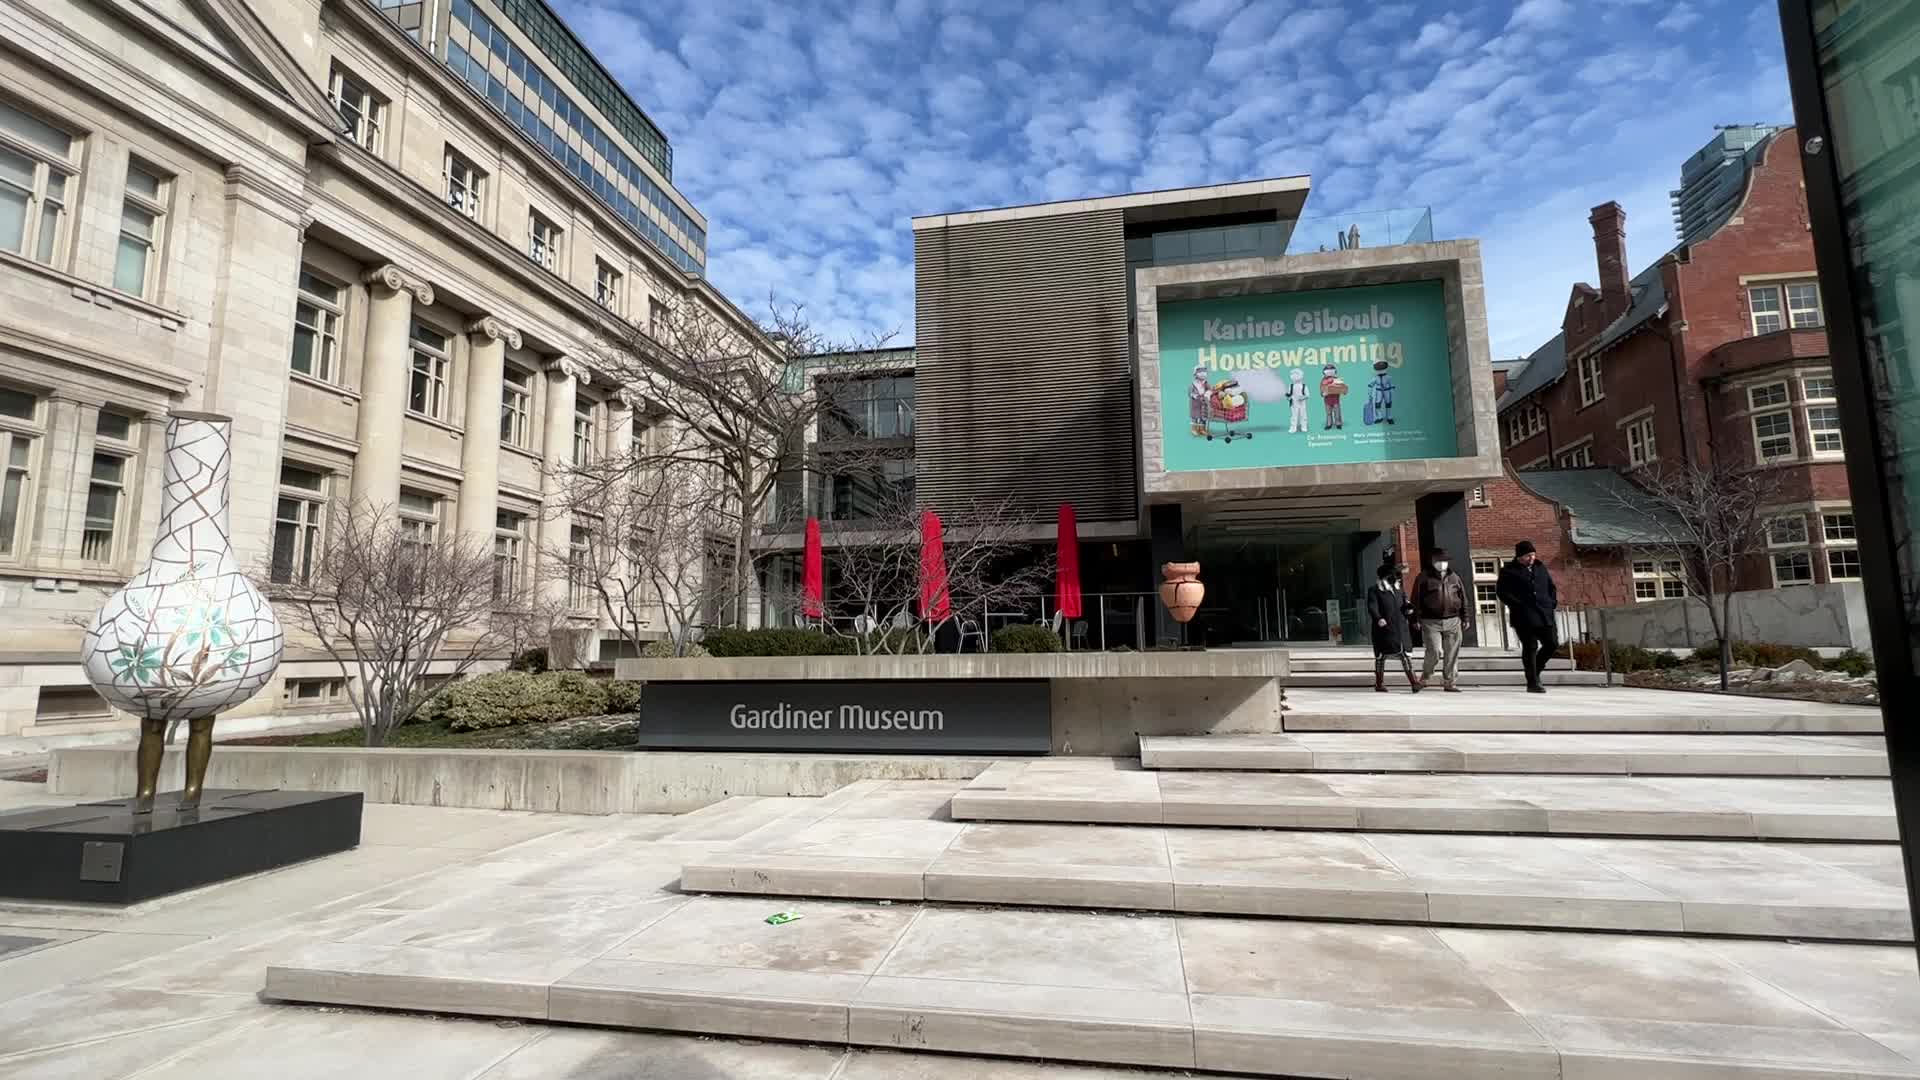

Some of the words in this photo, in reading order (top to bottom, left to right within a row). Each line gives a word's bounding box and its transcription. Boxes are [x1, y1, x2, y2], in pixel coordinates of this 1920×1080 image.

[1203, 316, 1286, 342] Karine
[1294, 304, 1395, 335] Giboulo
[1198, 336, 1404, 372] Housewarming
[730, 702, 833, 730] Gardiner
[839, 704, 944, 730] Museum
